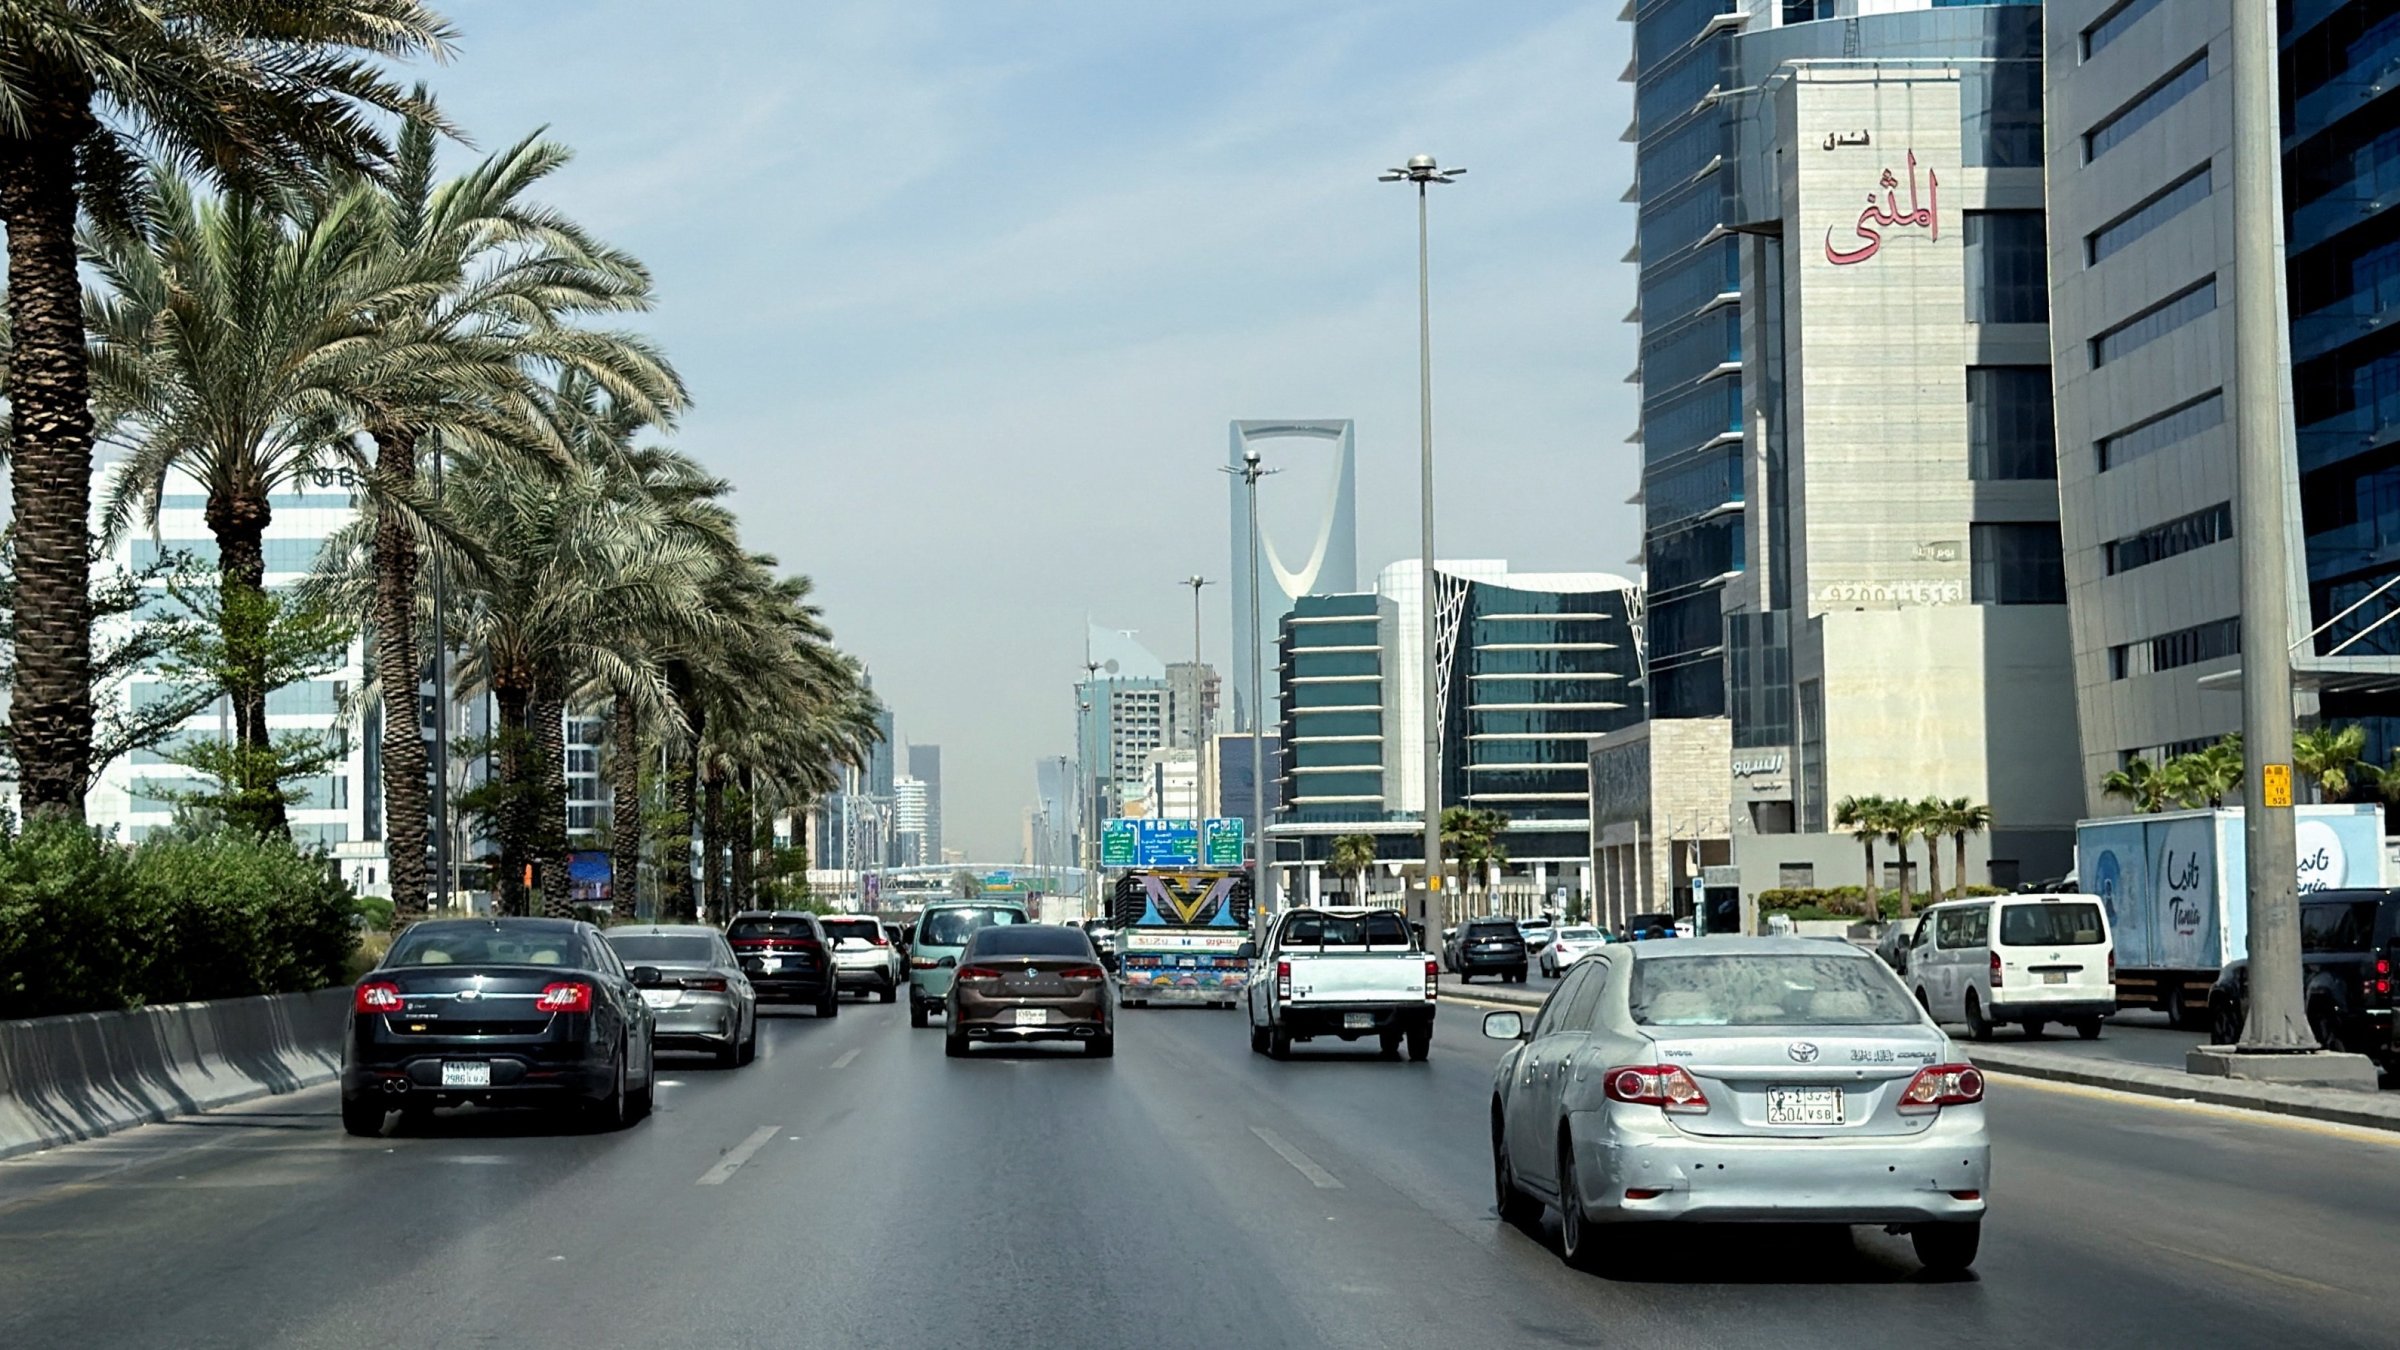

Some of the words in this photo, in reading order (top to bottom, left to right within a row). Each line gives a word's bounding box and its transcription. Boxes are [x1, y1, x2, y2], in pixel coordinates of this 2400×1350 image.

[1823, 128, 1870, 151] فندق
[1825, 147, 1938, 266] المثنى
[1830, 587, 1961, 602] 920011513
[2296, 847, 2329, 872] تاني
[2169, 896, 2201, 932] Tania
[1770, 1106, 1803, 1122] 2504
[1807, 1109, 1832, 1120] VSB
